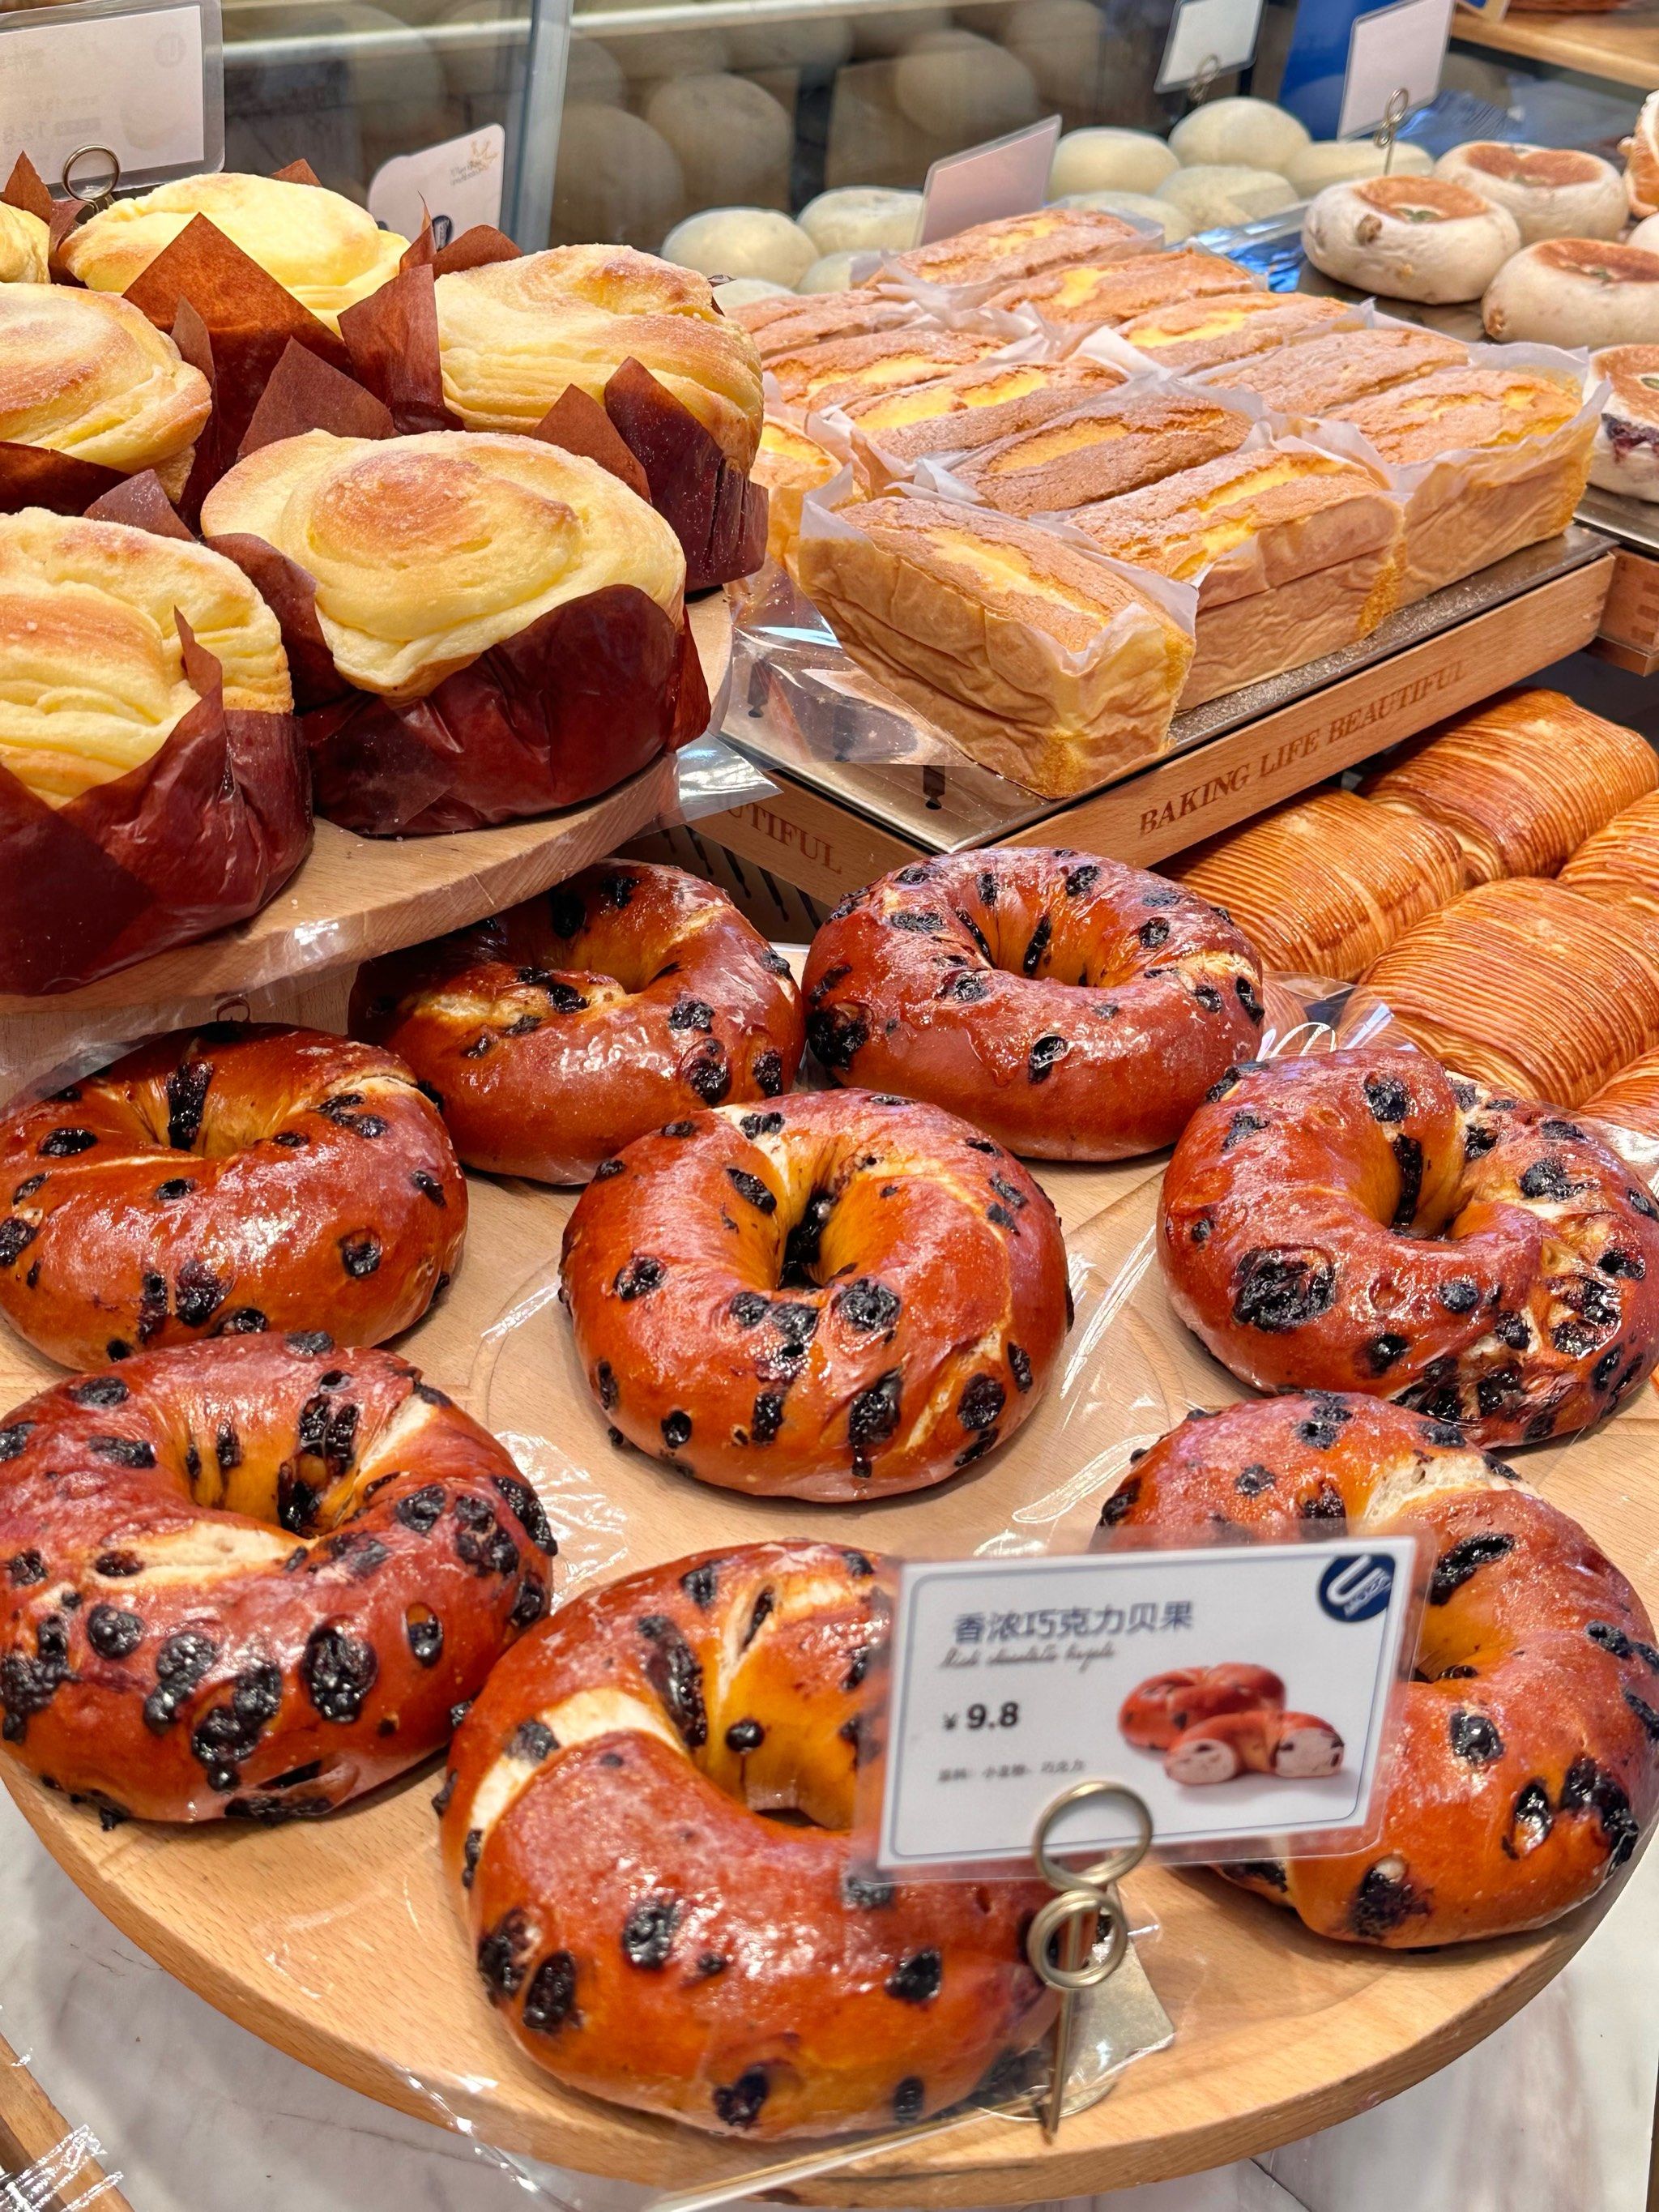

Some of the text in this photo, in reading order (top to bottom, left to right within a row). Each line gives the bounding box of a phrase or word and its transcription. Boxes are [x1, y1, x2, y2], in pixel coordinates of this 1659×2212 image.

[1140, 660, 1464, 836] BAKING LIFE BEAUTIFUL
[955, 1600, 1193, 1644] 香浓巧克力贝果
